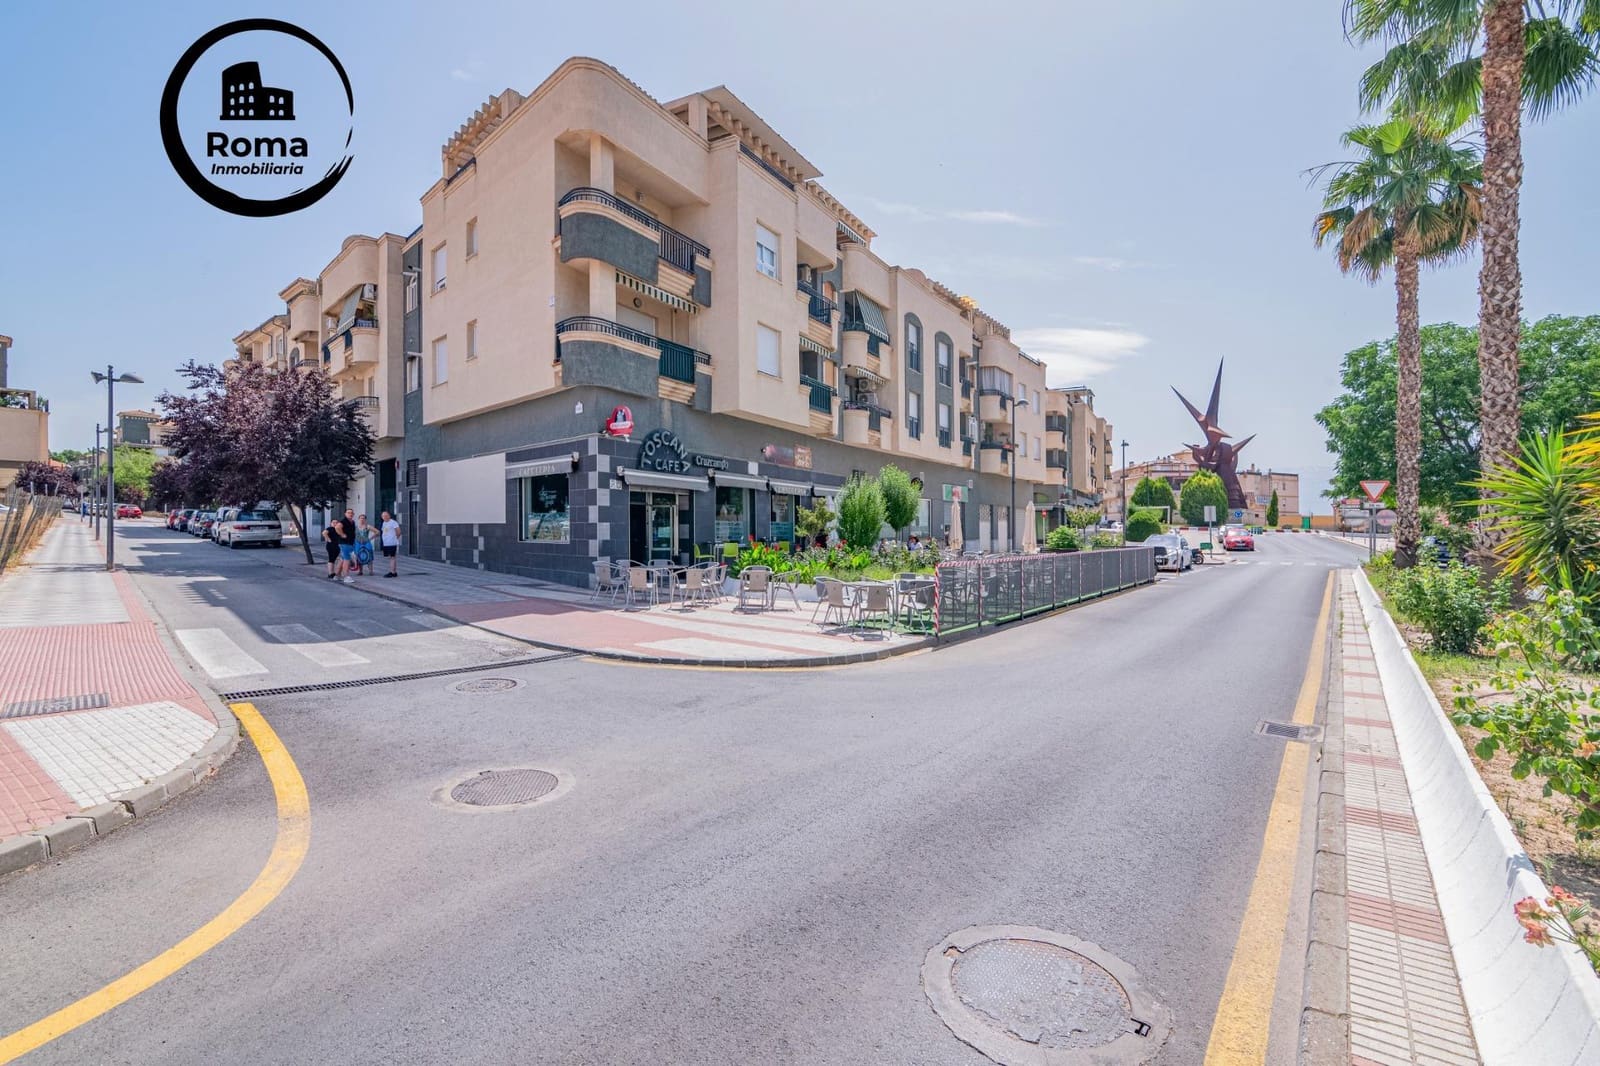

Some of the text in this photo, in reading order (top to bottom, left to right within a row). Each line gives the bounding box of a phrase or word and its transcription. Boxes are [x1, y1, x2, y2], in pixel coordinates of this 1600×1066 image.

[641, 431, 691, 472] TOSCANA
[655, 459, 680, 472] CAFE
[695, 455, 729, 470] Cruzcampo
